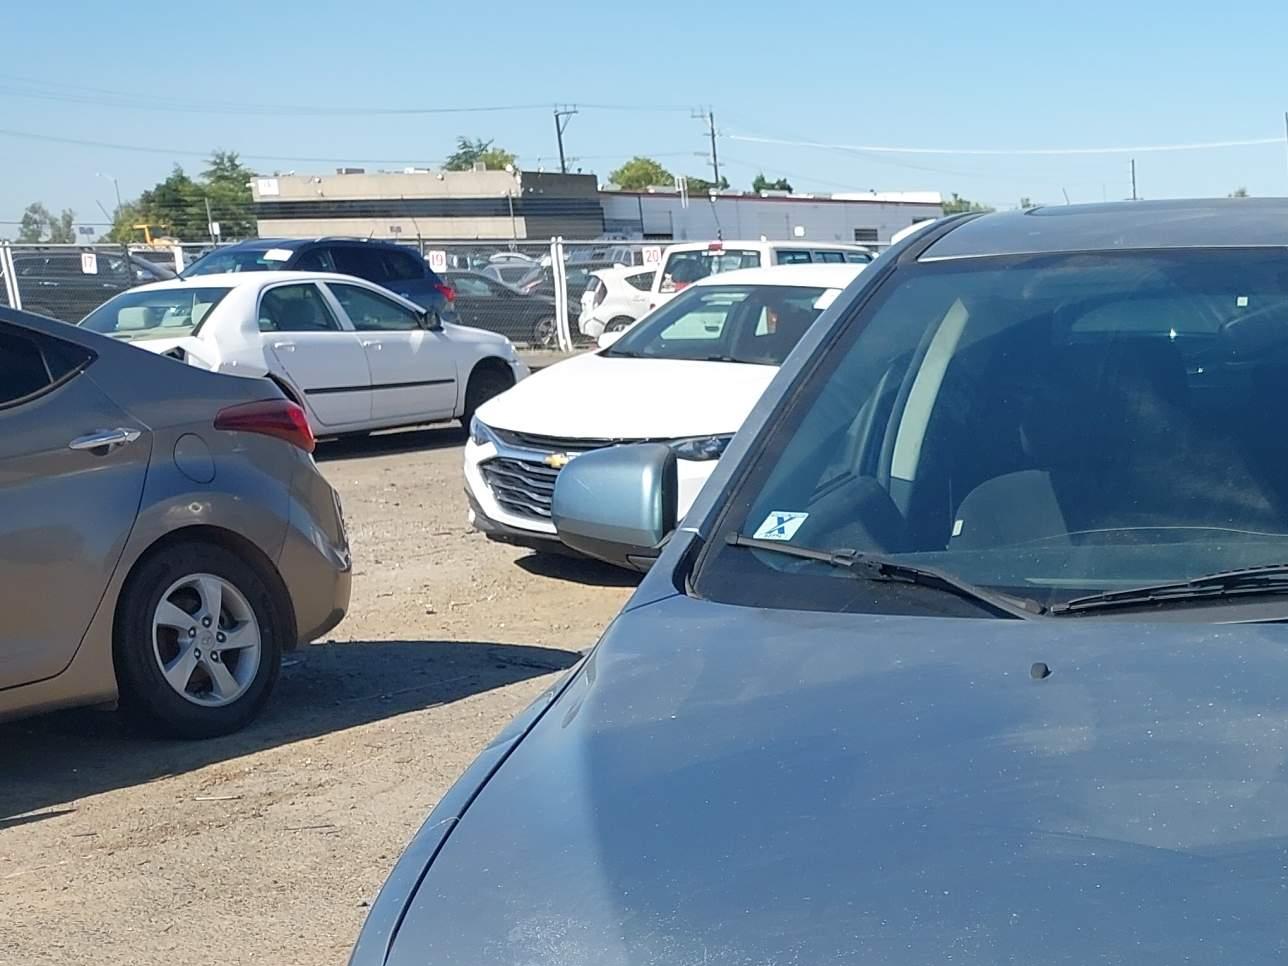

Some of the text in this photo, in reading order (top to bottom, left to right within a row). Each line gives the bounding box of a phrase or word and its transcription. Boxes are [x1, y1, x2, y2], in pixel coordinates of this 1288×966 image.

[83, 254, 95, 267] 17
[430, 253, 444, 267] 19
[645, 249, 659, 263] 20
